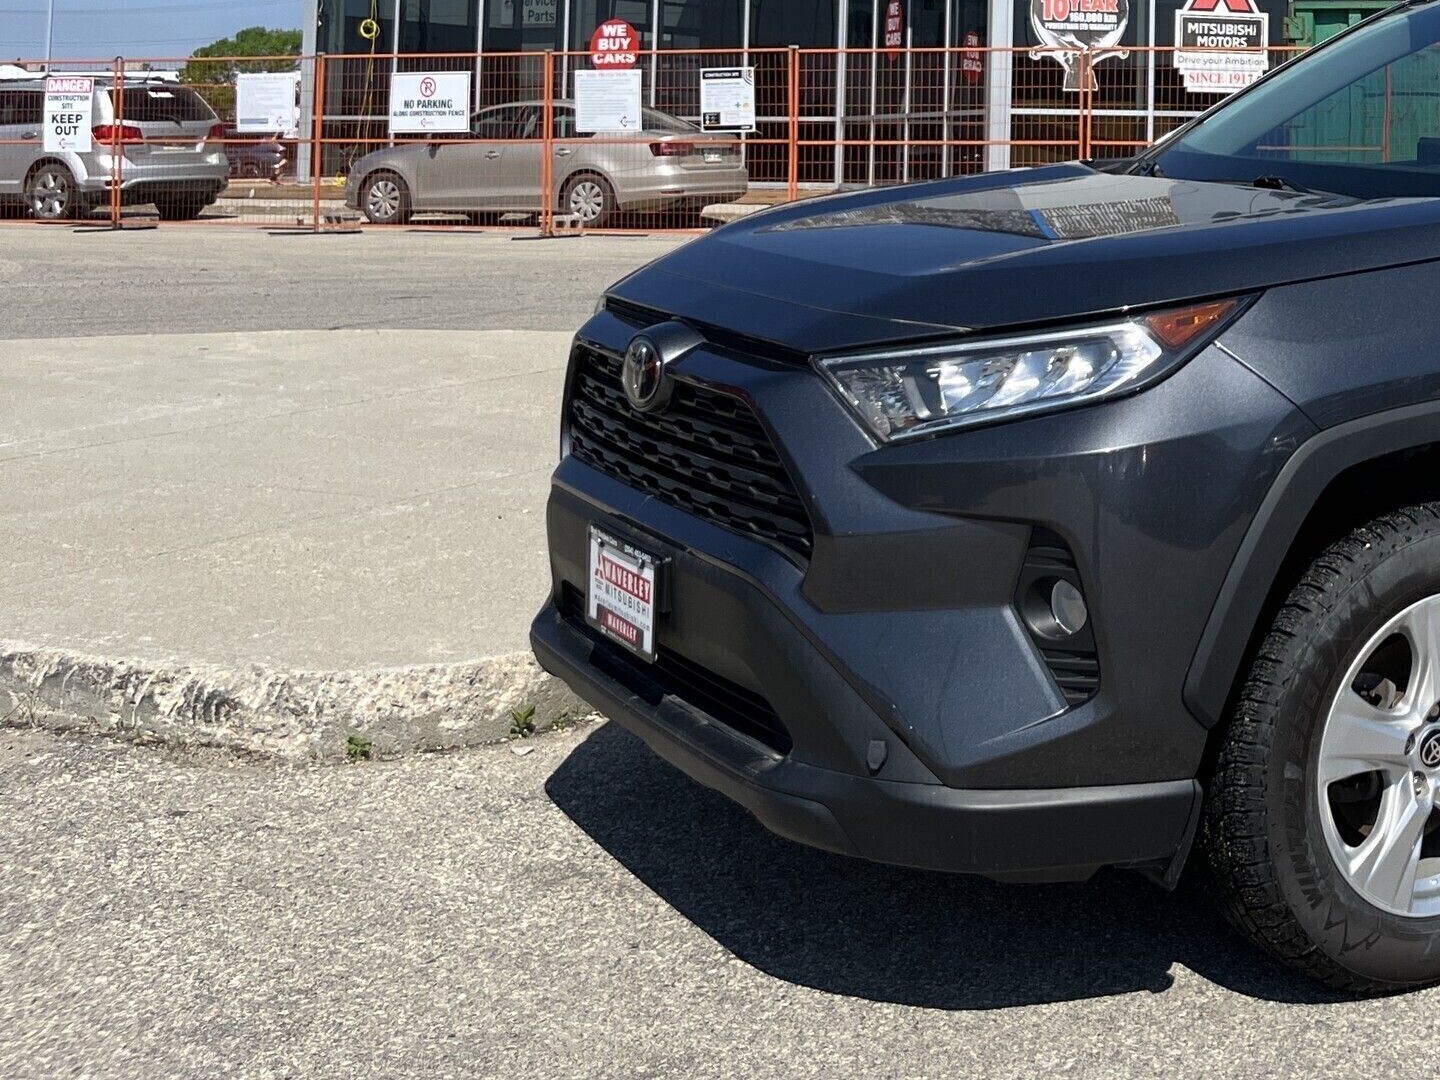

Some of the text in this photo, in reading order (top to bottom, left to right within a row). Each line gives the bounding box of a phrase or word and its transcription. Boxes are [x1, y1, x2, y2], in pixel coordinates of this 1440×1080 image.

[889, 2, 899, 15] WE
[528, 10, 555, 22] Parts
[603, 24, 627, 36] WE
[888, 18, 900, 31] BUY
[1187, 22, 1257, 36] MITSUBISHI
[598, 38, 631, 51] BUY
[885, 32, 901, 46] CARS
[1197, 36, 1247, 48] MOTORS
[592, 52, 636, 64] CARS
[1177, 55, 1202, 64] Drive
[1225, 57, 1265, 66] Ambition
[1188, 71, 1254, 85] SINCE 1917
[47, 80, 91, 92] DANGER
[47, 94, 90, 102] CONSTRUCTION
[403, 99, 453, 109] NO PARKING
[61, 102, 73, 110] SITE
[51, 114, 83, 124] KEEP
[55, 125, 79, 136] OUT
[604, 561, 650, 601] WAVERLEY
[605, 581, 650, 619] MITSUBISHI
[607, 612, 637, 642] WAVERLEY
